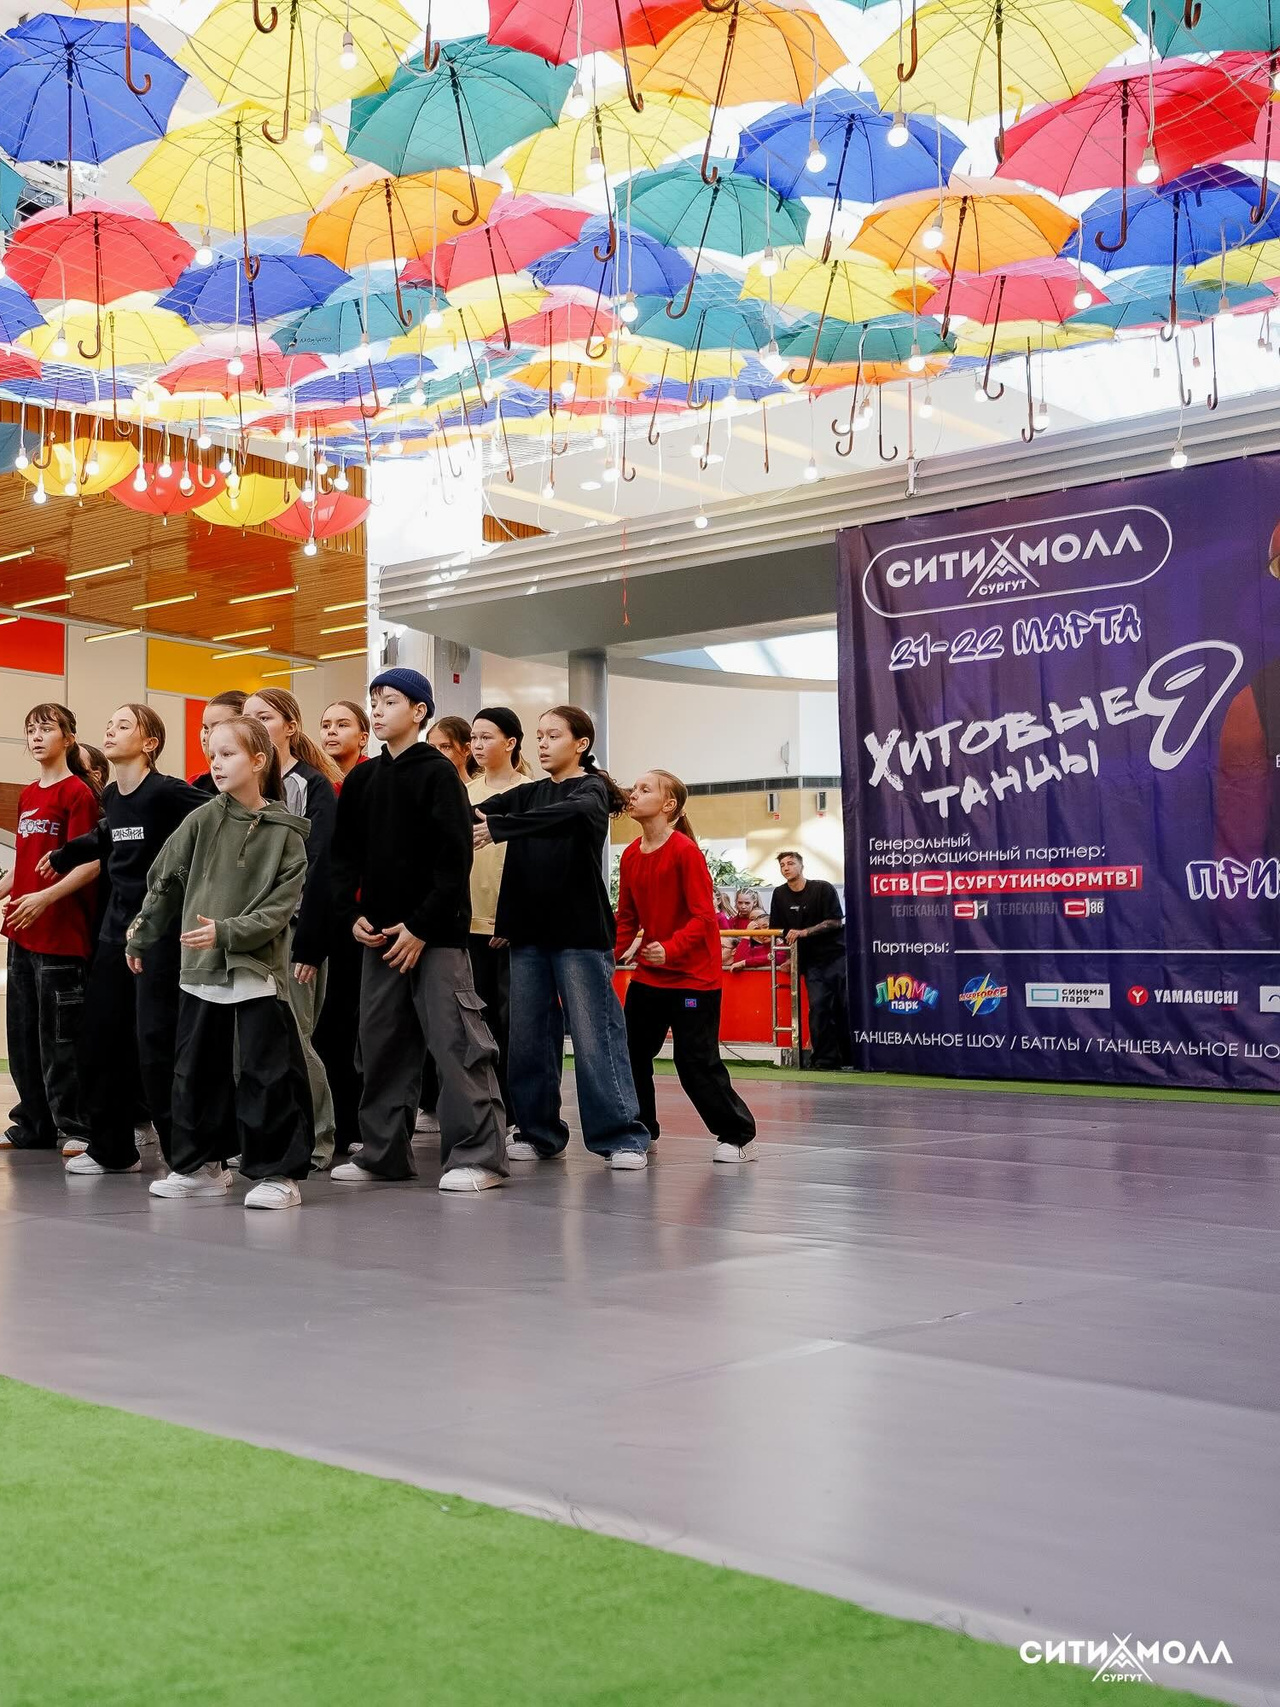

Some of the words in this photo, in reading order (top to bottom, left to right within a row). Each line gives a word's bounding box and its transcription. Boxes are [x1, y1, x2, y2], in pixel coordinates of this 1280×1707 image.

[886, 550, 985, 588] СИТИ
[1019, 524, 1143, 567] МОЛЛ
[978, 579, 1028, 596] СУРГУТ
[888, 625, 1005, 671] 21-22
[1012, 603, 1142, 657] МАРТА
[864, 686, 1139, 792] ХИТОВЫЕ
[921, 739, 1099, 819] ТАНЦЫ
[869, 832, 971, 852] Генеральный
[869, 846, 1021, 867] информационный
[1025, 844, 1106, 862] партнер:
[1185, 856, 1280, 901] ПРИ
[890, 904, 948, 918] ТЕЛЕКАНАЛ
[996, 902, 1058, 915] ТЕЛЕКАНАЛ
[873, 940, 950, 956] Партнеры:
[891, 1000, 919, 1010] парк
[1061, 996, 1090, 1005] парк
[1154, 989, 1239, 1005] YAMAGUCHI
[854, 1031, 963, 1047] ТАНЦЕВАЛЬНОЕ
[966, 1034, 1006, 1048] ШОУ
[1021, 1035, 1080, 1052] БАТТЛЫ
[1097, 1038, 1239, 1057] ТАНЦЕВАЛЬНОЕ
